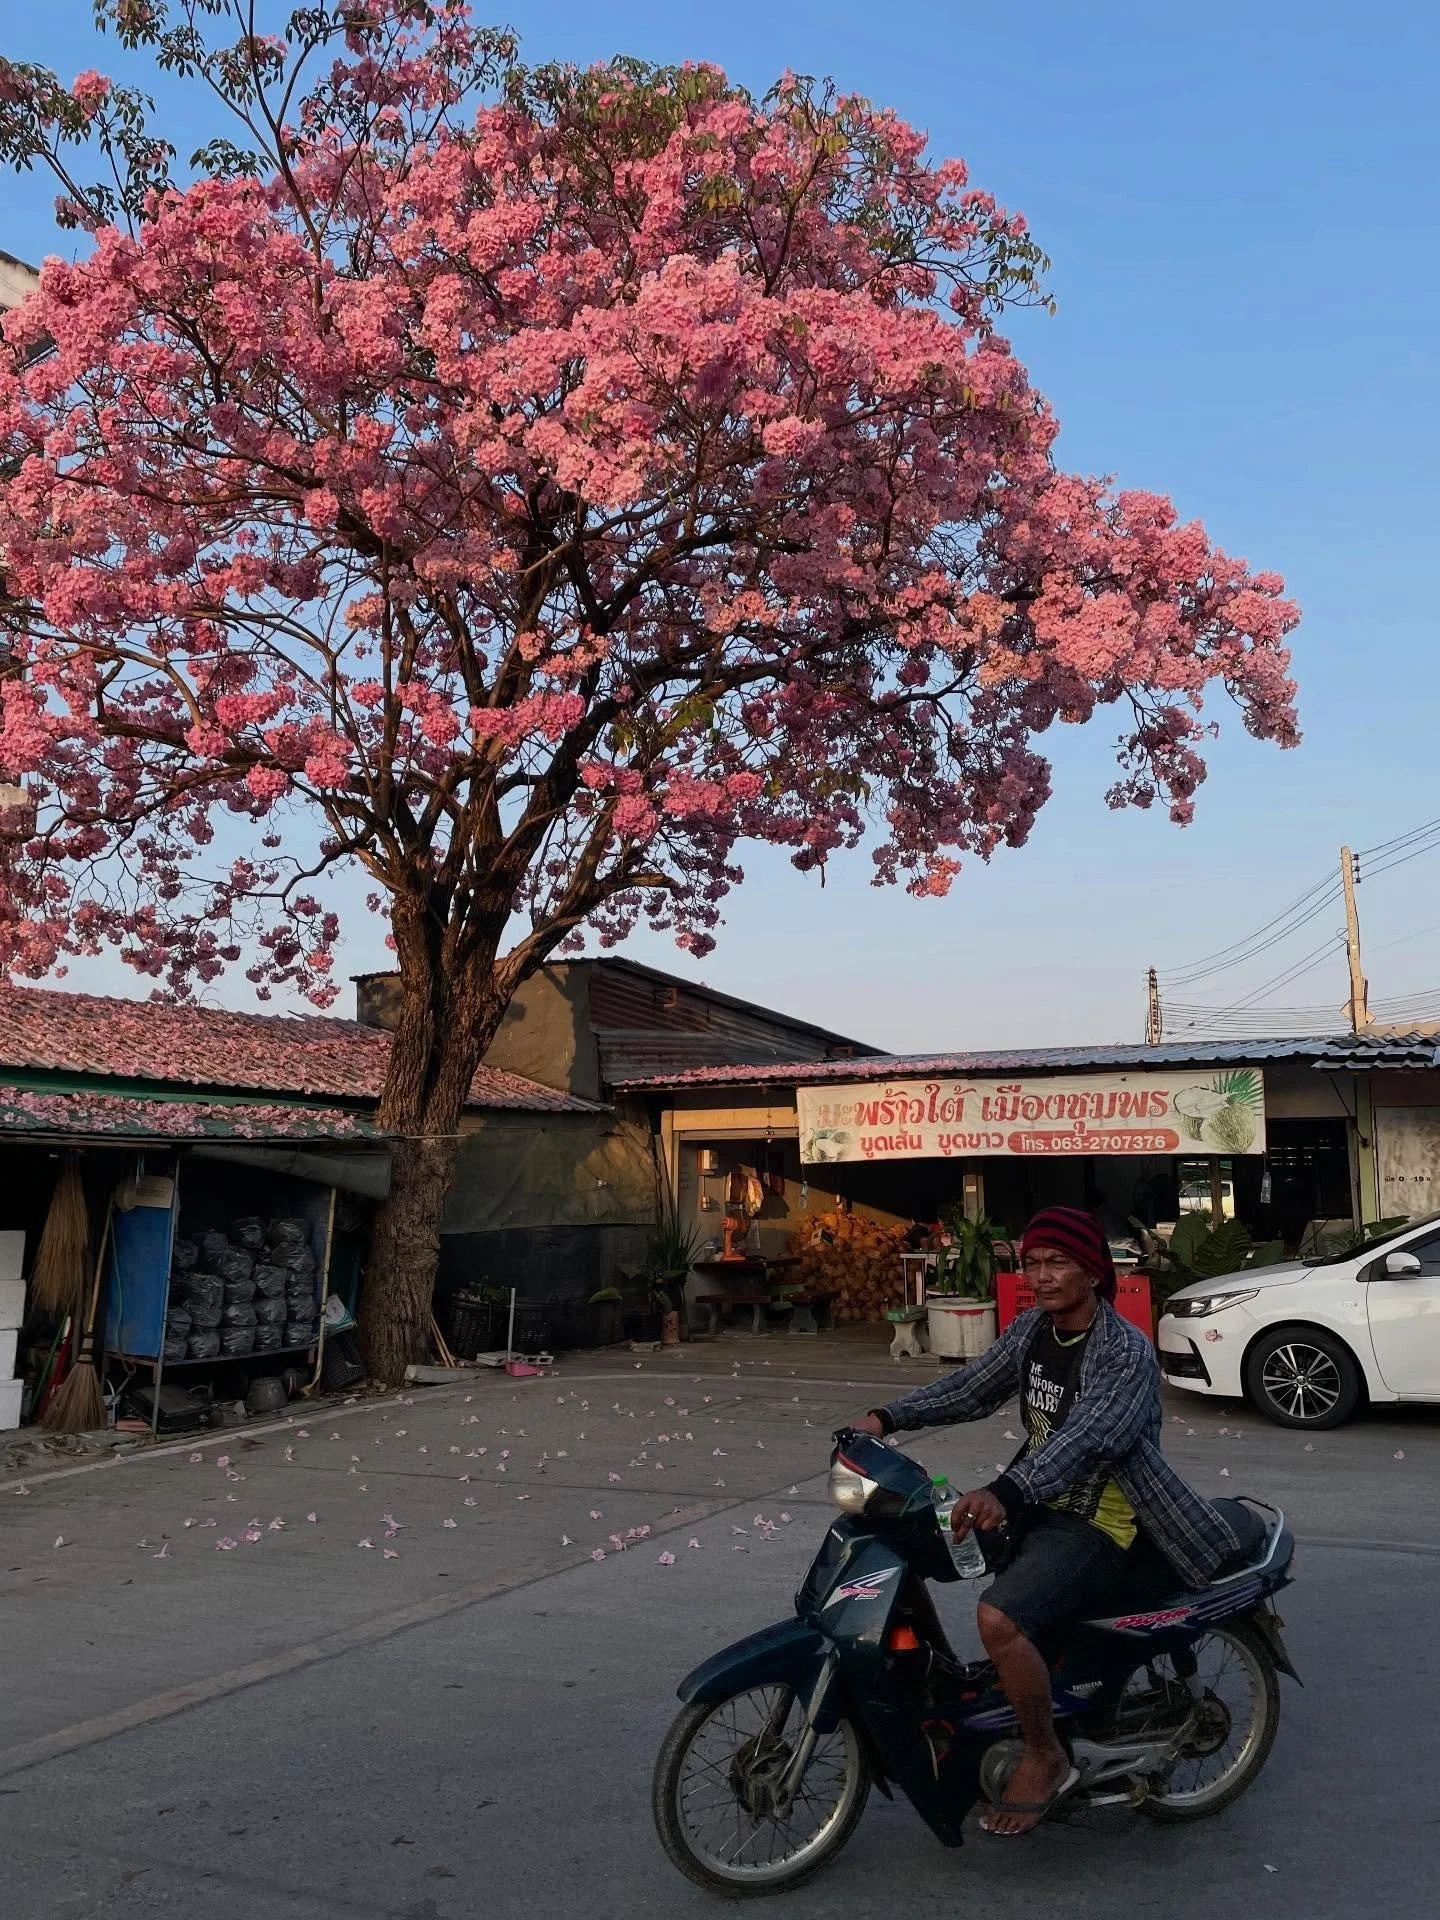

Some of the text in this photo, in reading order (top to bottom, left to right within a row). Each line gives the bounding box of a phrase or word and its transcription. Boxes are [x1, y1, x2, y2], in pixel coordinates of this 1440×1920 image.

[817, 1083, 1170, 1136] มะพร้าวใต้ เมืองชุมพร
[938, 1132, 1004, 1156] ขูดขาว
[1051, 1135, 1166, 1151] 063-2707376
[1030, 1360, 1043, 1377] HE
